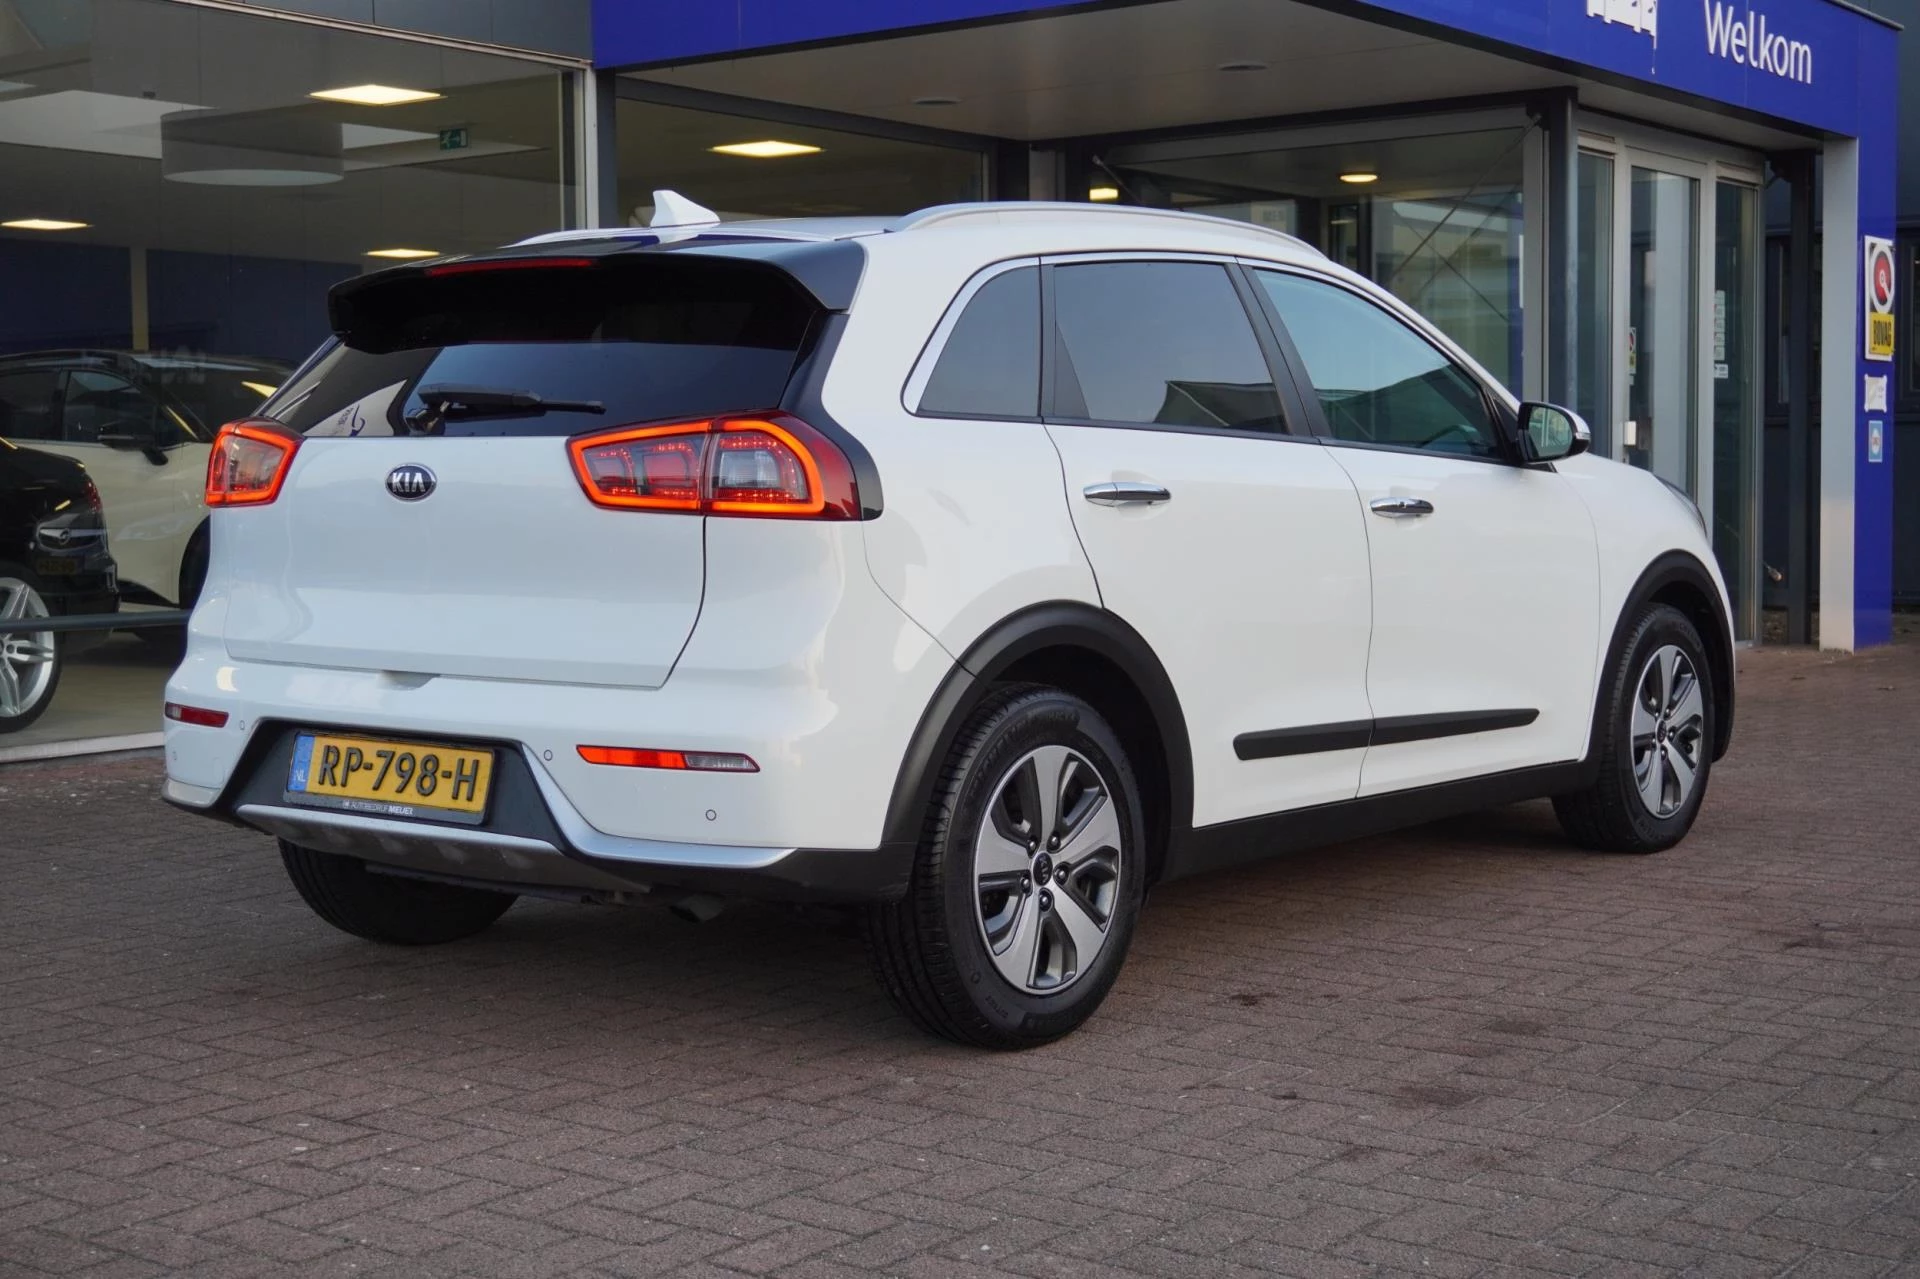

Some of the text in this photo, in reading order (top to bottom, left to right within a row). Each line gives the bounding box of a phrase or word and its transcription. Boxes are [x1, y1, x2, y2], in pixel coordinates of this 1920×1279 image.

[1704, 0, 1812, 84] Welkom
[392, 472, 426, 493] KIA
[318, 745, 480, 802] RP-798-H
